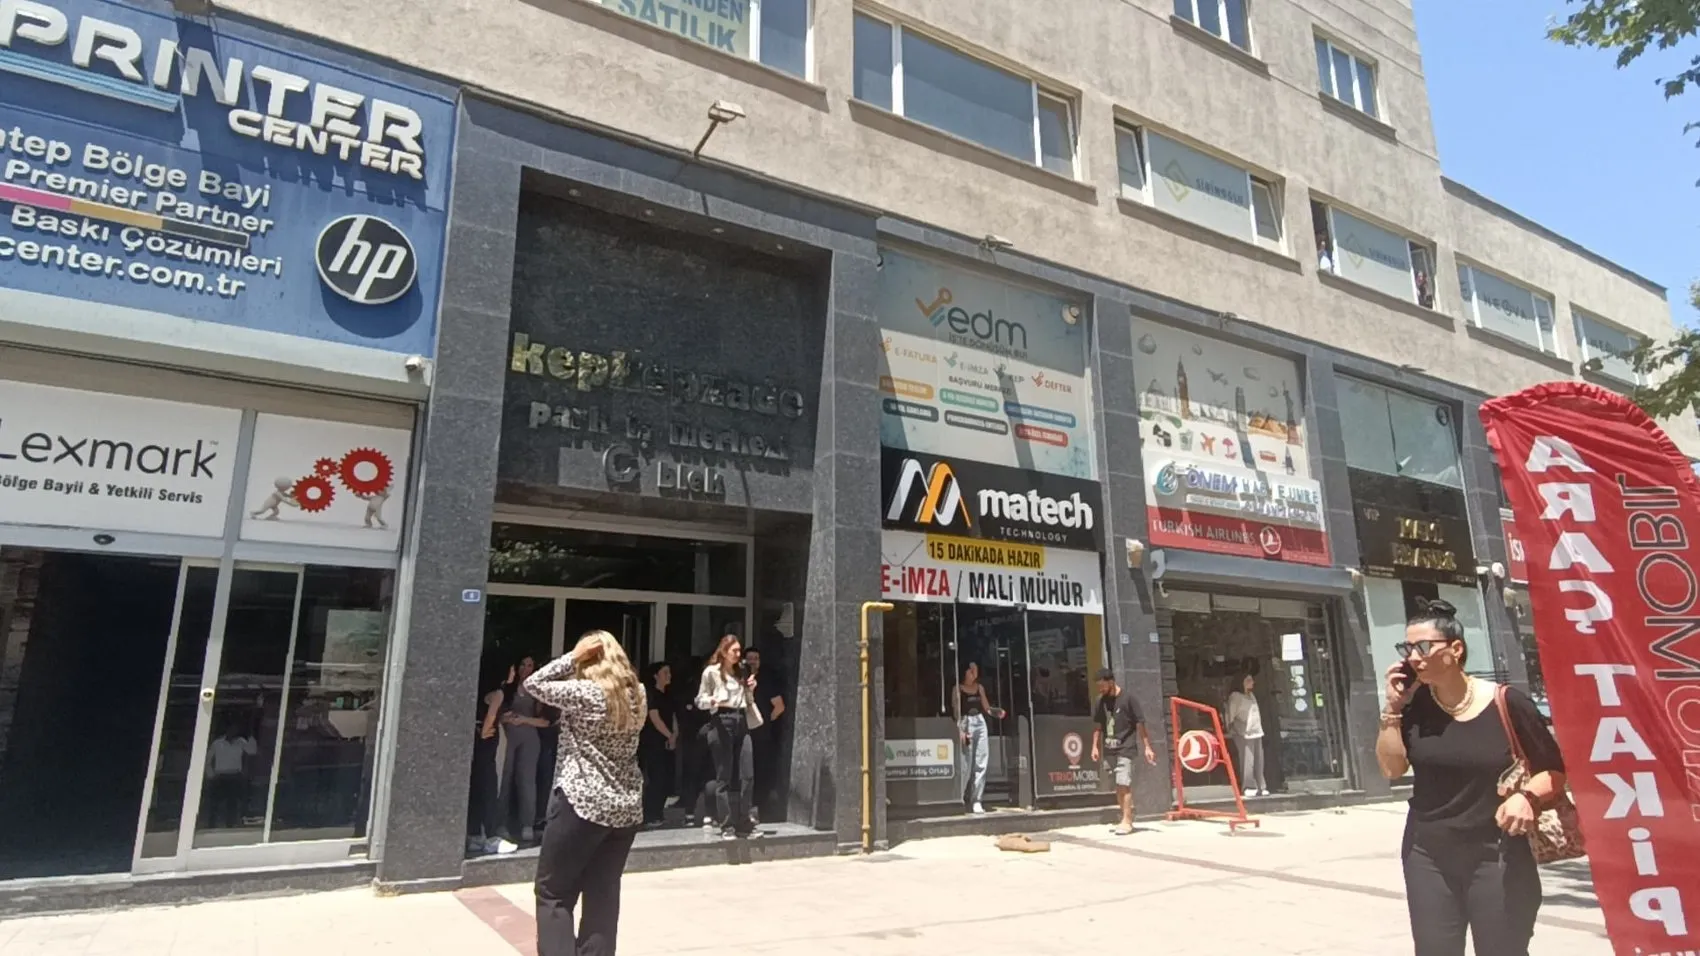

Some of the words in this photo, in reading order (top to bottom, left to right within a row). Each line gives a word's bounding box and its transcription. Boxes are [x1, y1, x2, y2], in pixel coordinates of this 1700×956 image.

[618, 0, 737, 53] SATILIK
[0, 0, 423, 152] PRINTER
[228, 109, 424, 180] CENTER
[4, 159, 147, 208] Premier
[156, 192, 274, 234] Partner
[83, 143, 187, 189] Bölge
[199, 170, 272, 207] Bayi
[0, 236, 246, 297] center.com.tr
[11, 204, 109, 243] Baskı
[120, 227, 283, 277] Çözümleri
[329, 216, 408, 301] hp
[948, 307, 1027, 350] edm
[0, 417, 218, 480] Lexmark
[0, 473, 38, 492] ölge
[43, 478, 83, 495] Bayii
[88, 482, 100, 496] &
[106, 484, 155, 501] Yetkili
[158, 488, 204, 505] Servis
[978, 488, 1093, 530] matech
[929, 541, 944, 560] 15
[1008, 549, 1041, 569] HAZIR
[1000, 526, 1068, 543] TECHNOLOGY
[1152, 519, 1203, 538] TURKISH
[1206, 526, 1256, 545] AIRLINES
[1020, 571, 1084, 607] MÜHÜR
